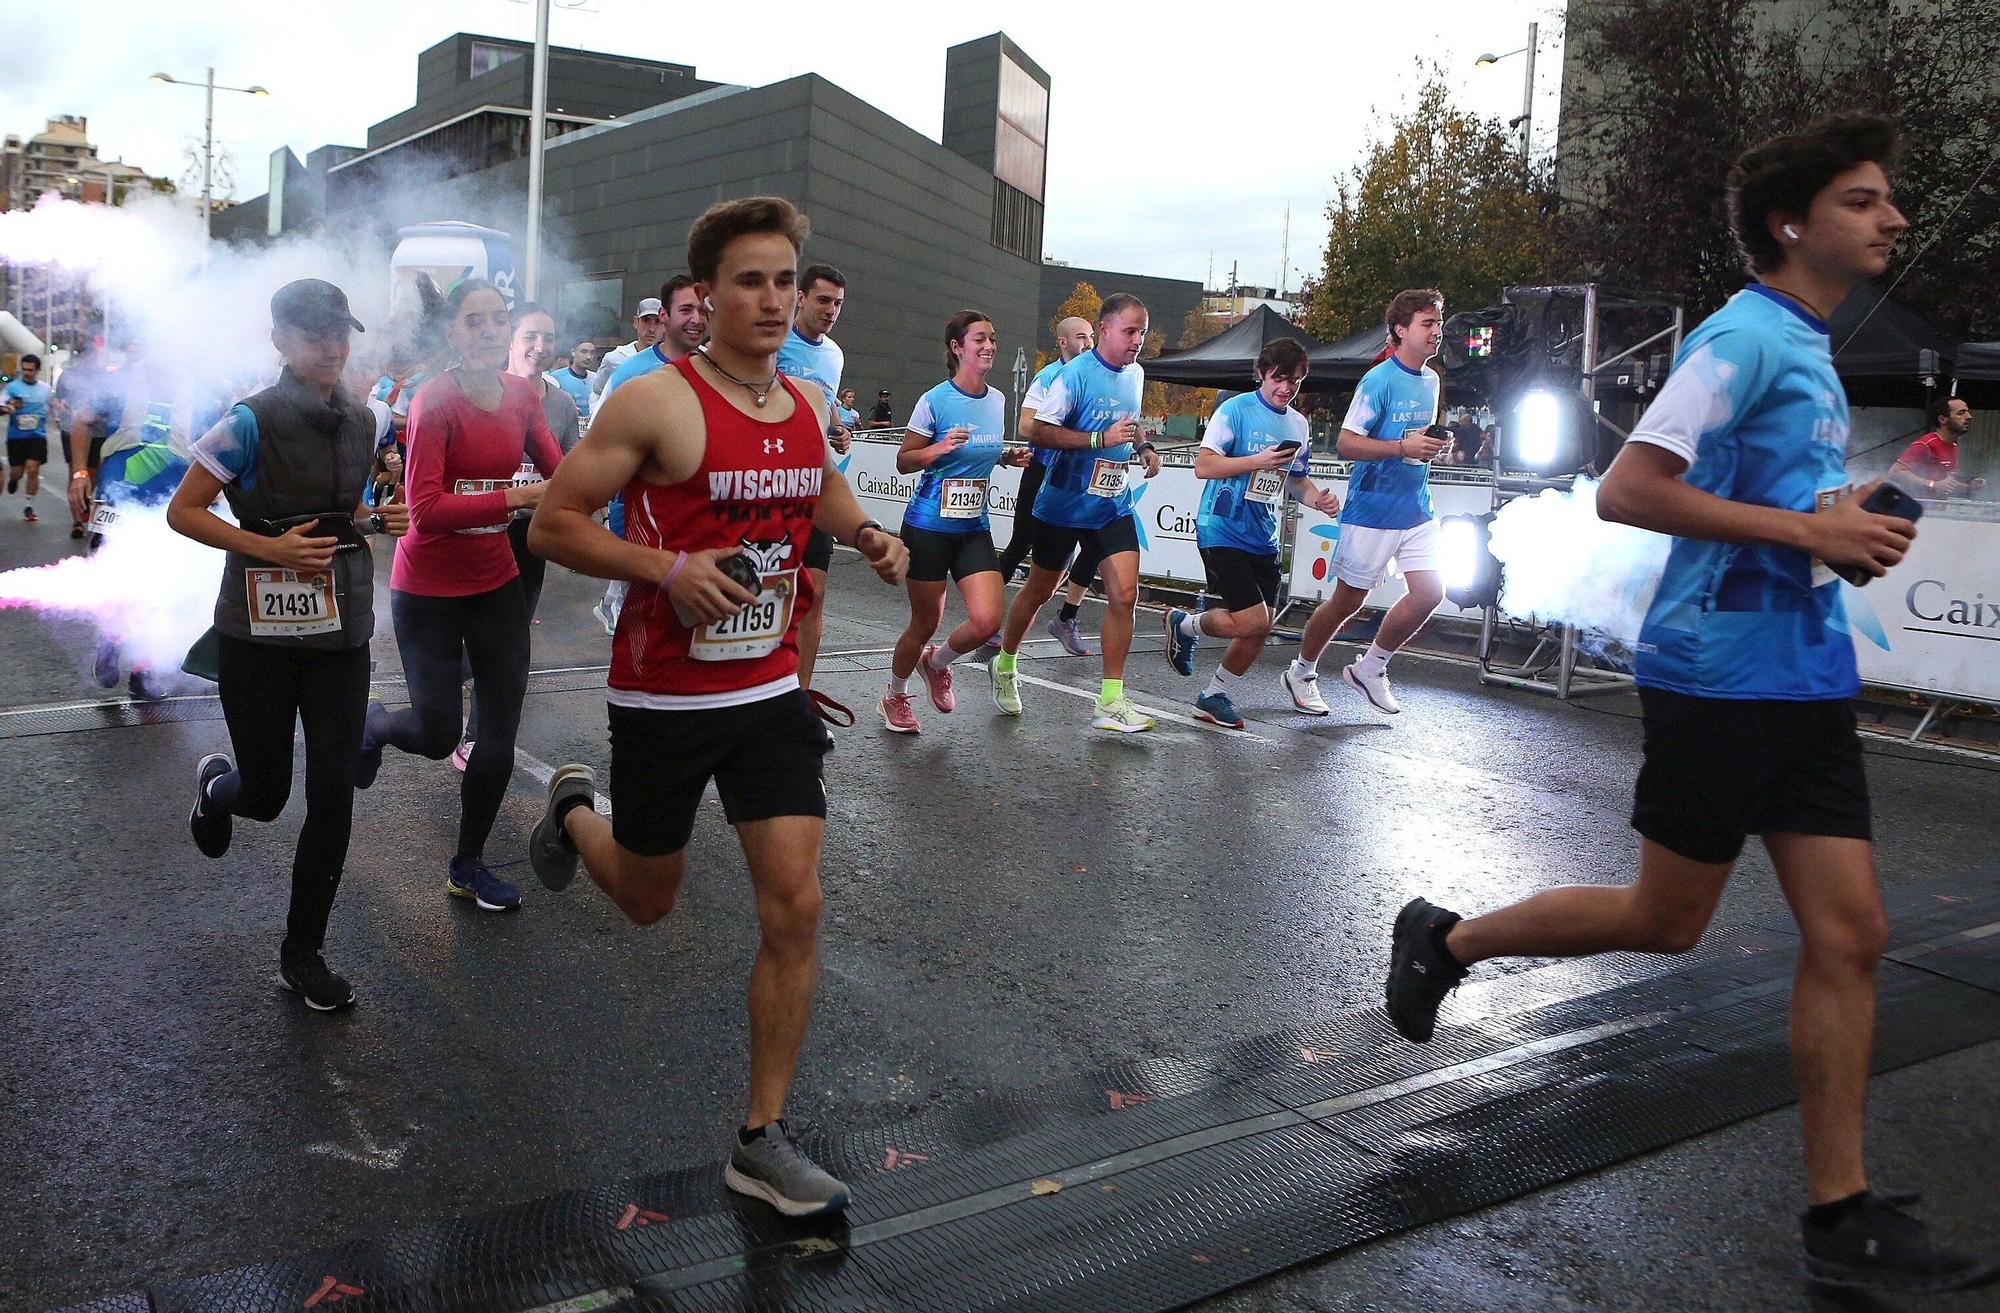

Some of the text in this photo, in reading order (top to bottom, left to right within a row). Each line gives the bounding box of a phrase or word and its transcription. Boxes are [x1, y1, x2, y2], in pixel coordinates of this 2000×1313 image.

[1392, 412, 1411, 423] LAS
[950, 492, 982, 507] 21342
[264, 593, 319, 616] 21431
